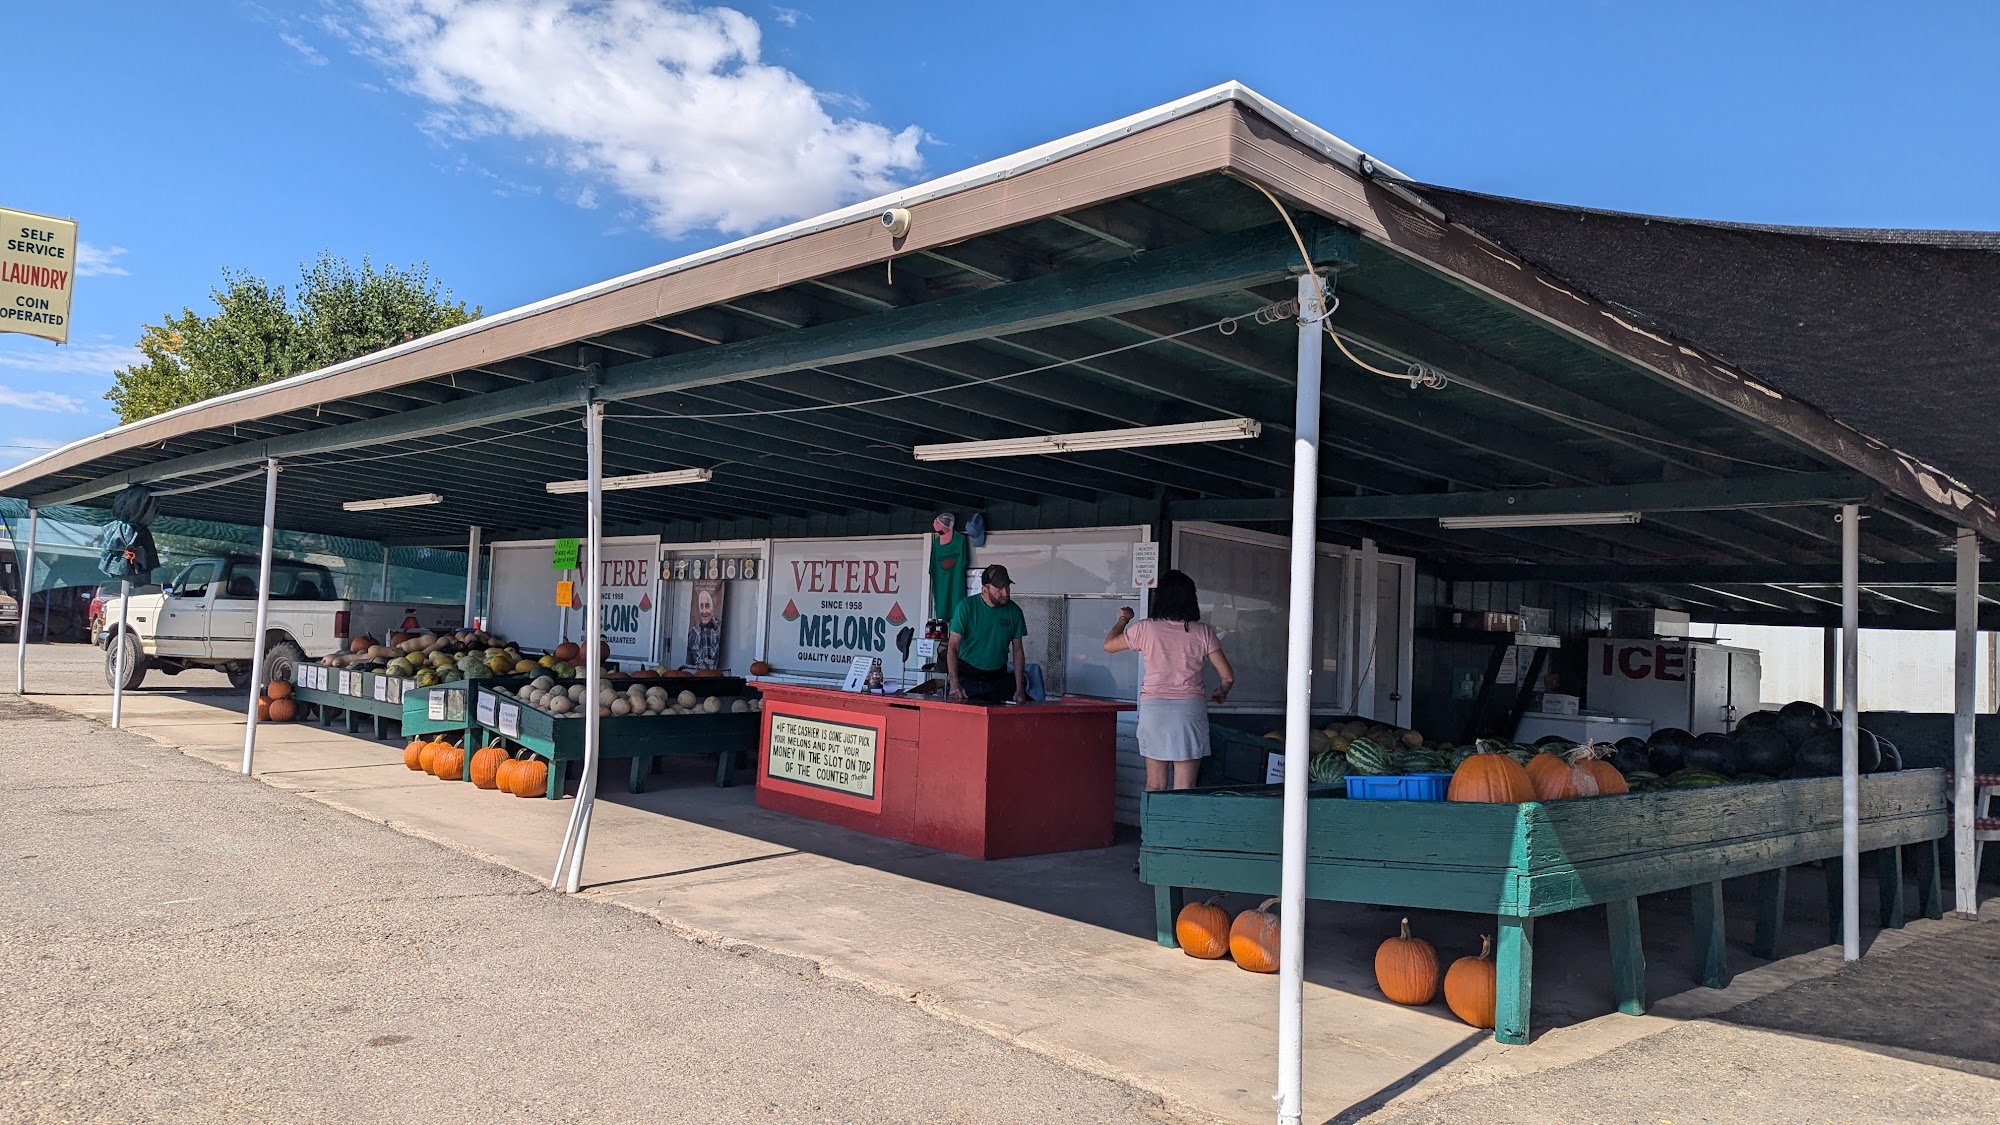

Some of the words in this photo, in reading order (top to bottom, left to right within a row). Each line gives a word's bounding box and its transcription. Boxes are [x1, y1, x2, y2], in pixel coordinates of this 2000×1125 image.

[20, 228, 54, 242] SELF
[8, 240, 65, 258] SERVICE
[2, 261, 68, 290] LAUNDRY
[16, 296, 49, 310] COIN
[0, 308, 63, 325] OPERATED
[578, 560, 649, 587] VTERE
[790, 559, 900, 594] VETERE
[821, 601, 842, 610] SINCE
[845, 602, 862, 610] 1958
[605, 636, 636, 644] UARANTEED
[799, 614, 886, 652] MELONS
[798, 652, 828, 661] QUALITY
[831, 654, 882, 666] GUARED
[1603, 642, 1686, 681] ICE
[774, 734, 785, 744] YOUR
[788, 737, 811, 748] MELONS
[813, 741, 826, 751] AND
[828, 743, 840, 753] PUT
[844, 746, 859, 757] YOUR
[787, 724, 797, 735] THE
[798, 725, 819, 738] CASHIER
[822, 729, 827, 740] IS
[843, 733, 857, 745] JUST
[859, 736, 870, 747] PICK
[773, 745, 795, 759] MONEY
[798, 750, 805, 761] IN
[809, 752, 820, 764] THE
[824, 754, 843, 768] SLOT
[846, 758, 856, 771] ON
[858, 760, 871, 774] TOP
[785, 762, 793, 773] OF
[798, 764, 810, 777] THE
[817, 768, 848, 785] COUNTER
